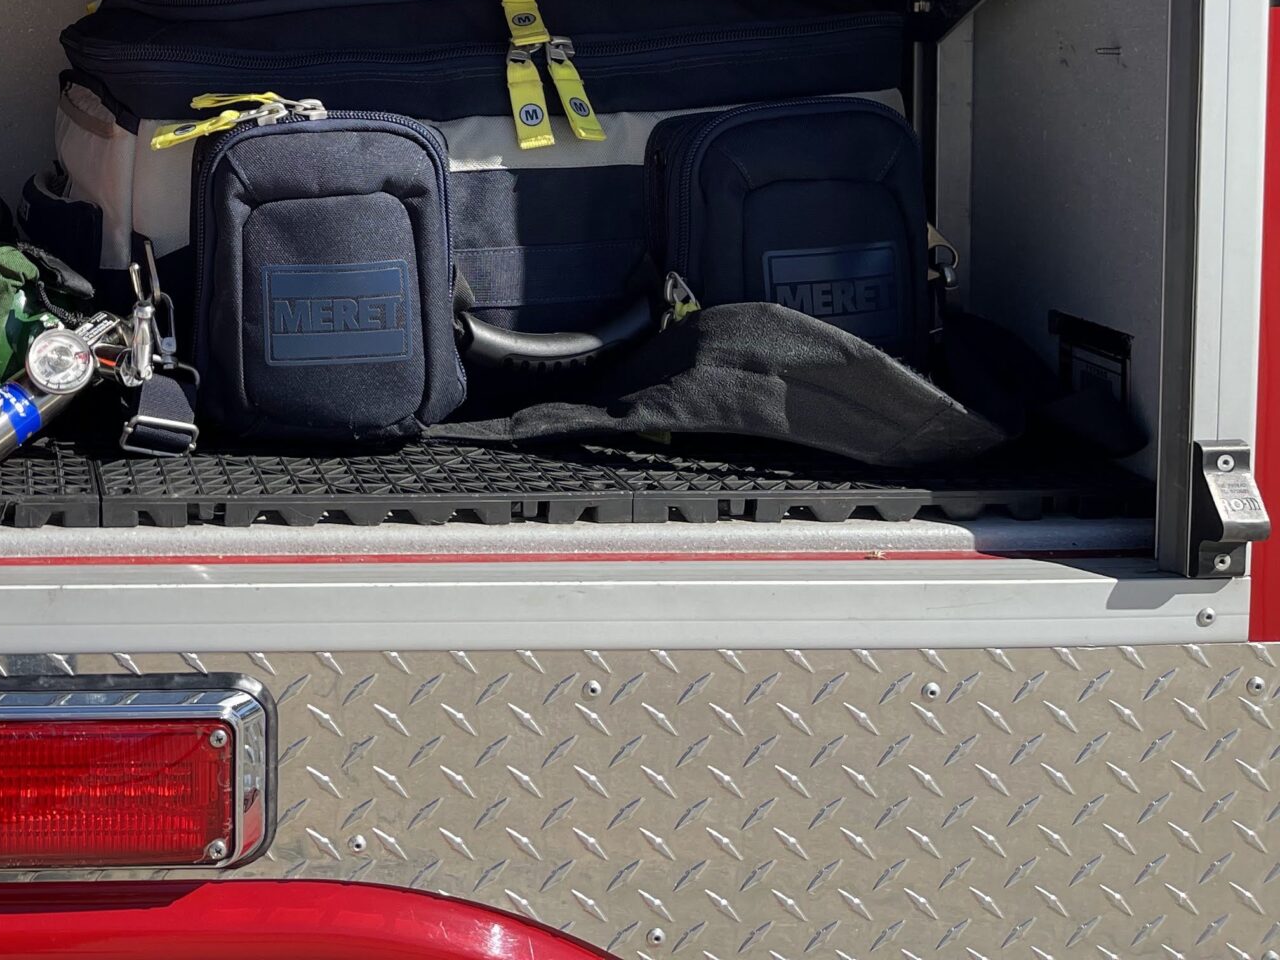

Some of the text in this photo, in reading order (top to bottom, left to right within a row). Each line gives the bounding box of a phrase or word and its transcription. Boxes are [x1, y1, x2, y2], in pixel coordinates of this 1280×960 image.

[524, 109, 539, 121] M
[272, 296, 401, 334] MERET
[775, 278, 892, 316] MERET
